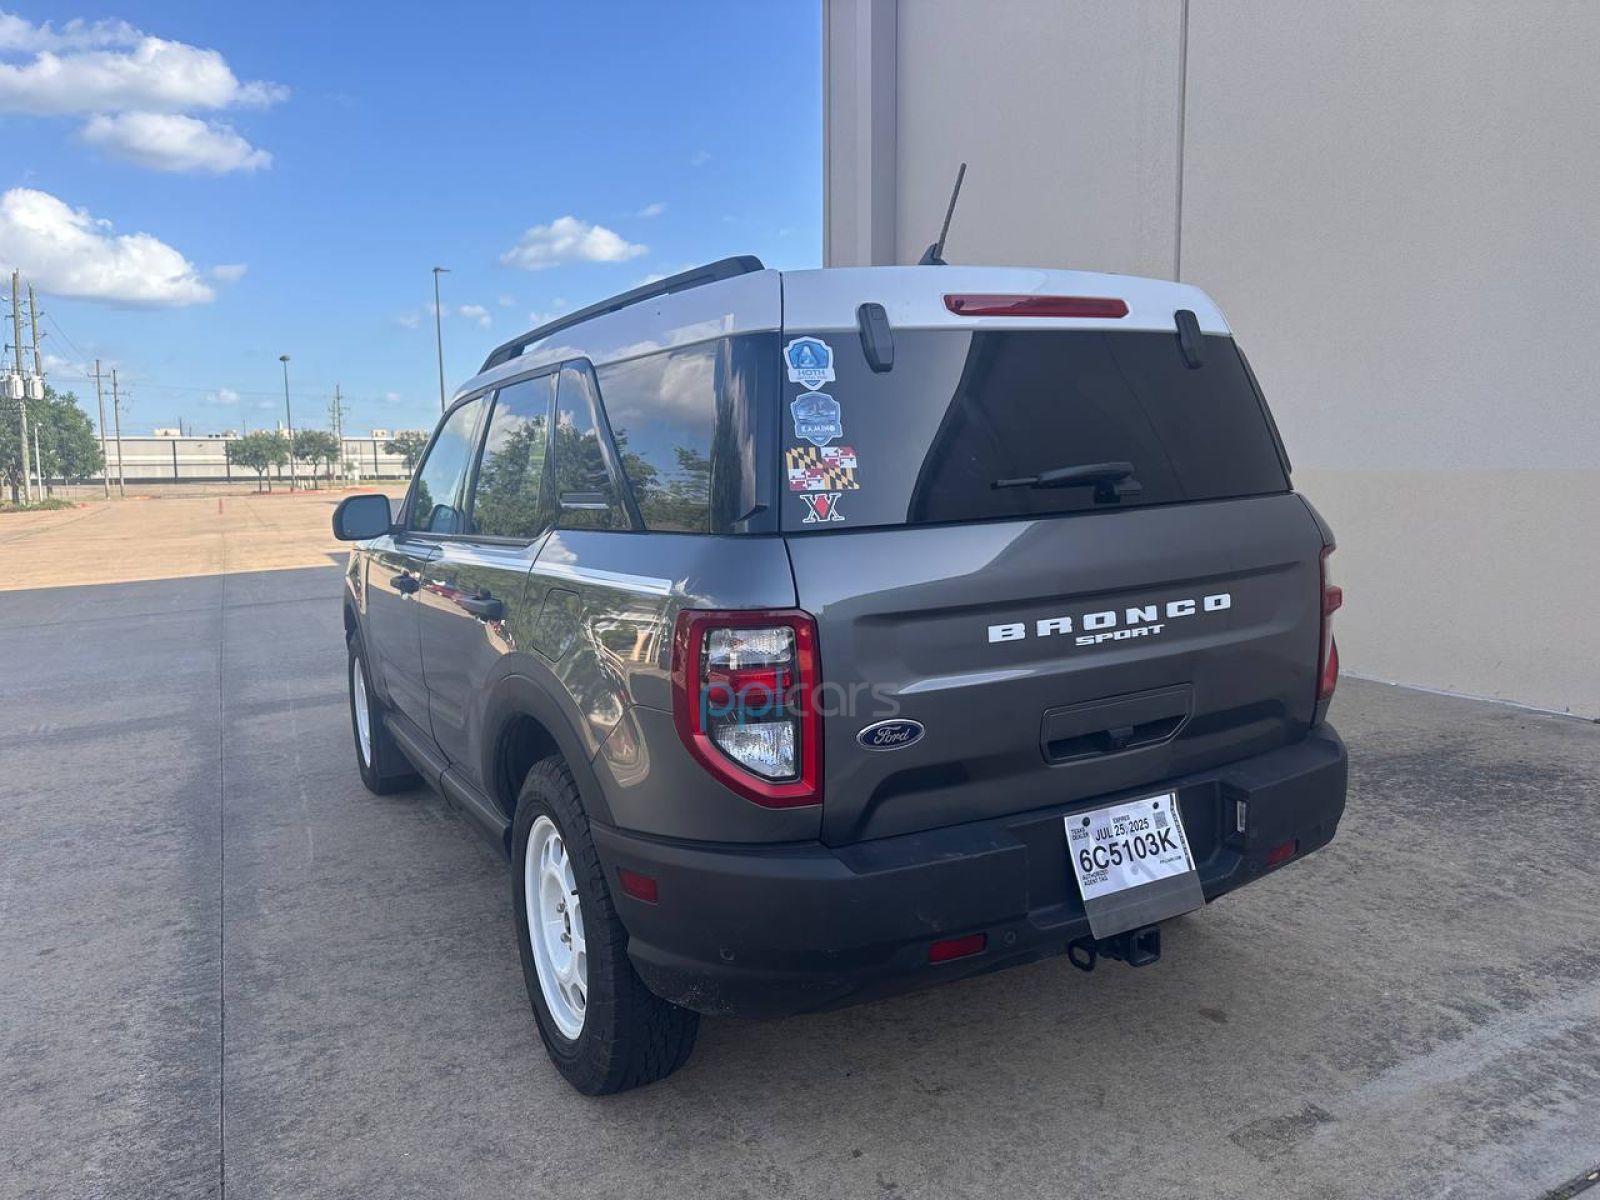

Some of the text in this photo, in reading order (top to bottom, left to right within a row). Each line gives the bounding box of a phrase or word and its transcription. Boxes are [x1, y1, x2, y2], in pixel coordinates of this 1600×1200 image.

[988, 593, 1231, 643] BRONCO
[1075, 624, 1165, 646] SPORT
[873, 725, 910, 745] Ford
[1095, 818, 1150, 842] JUL 25, 2025
[1080, 827, 1178, 873] 6C5103K
